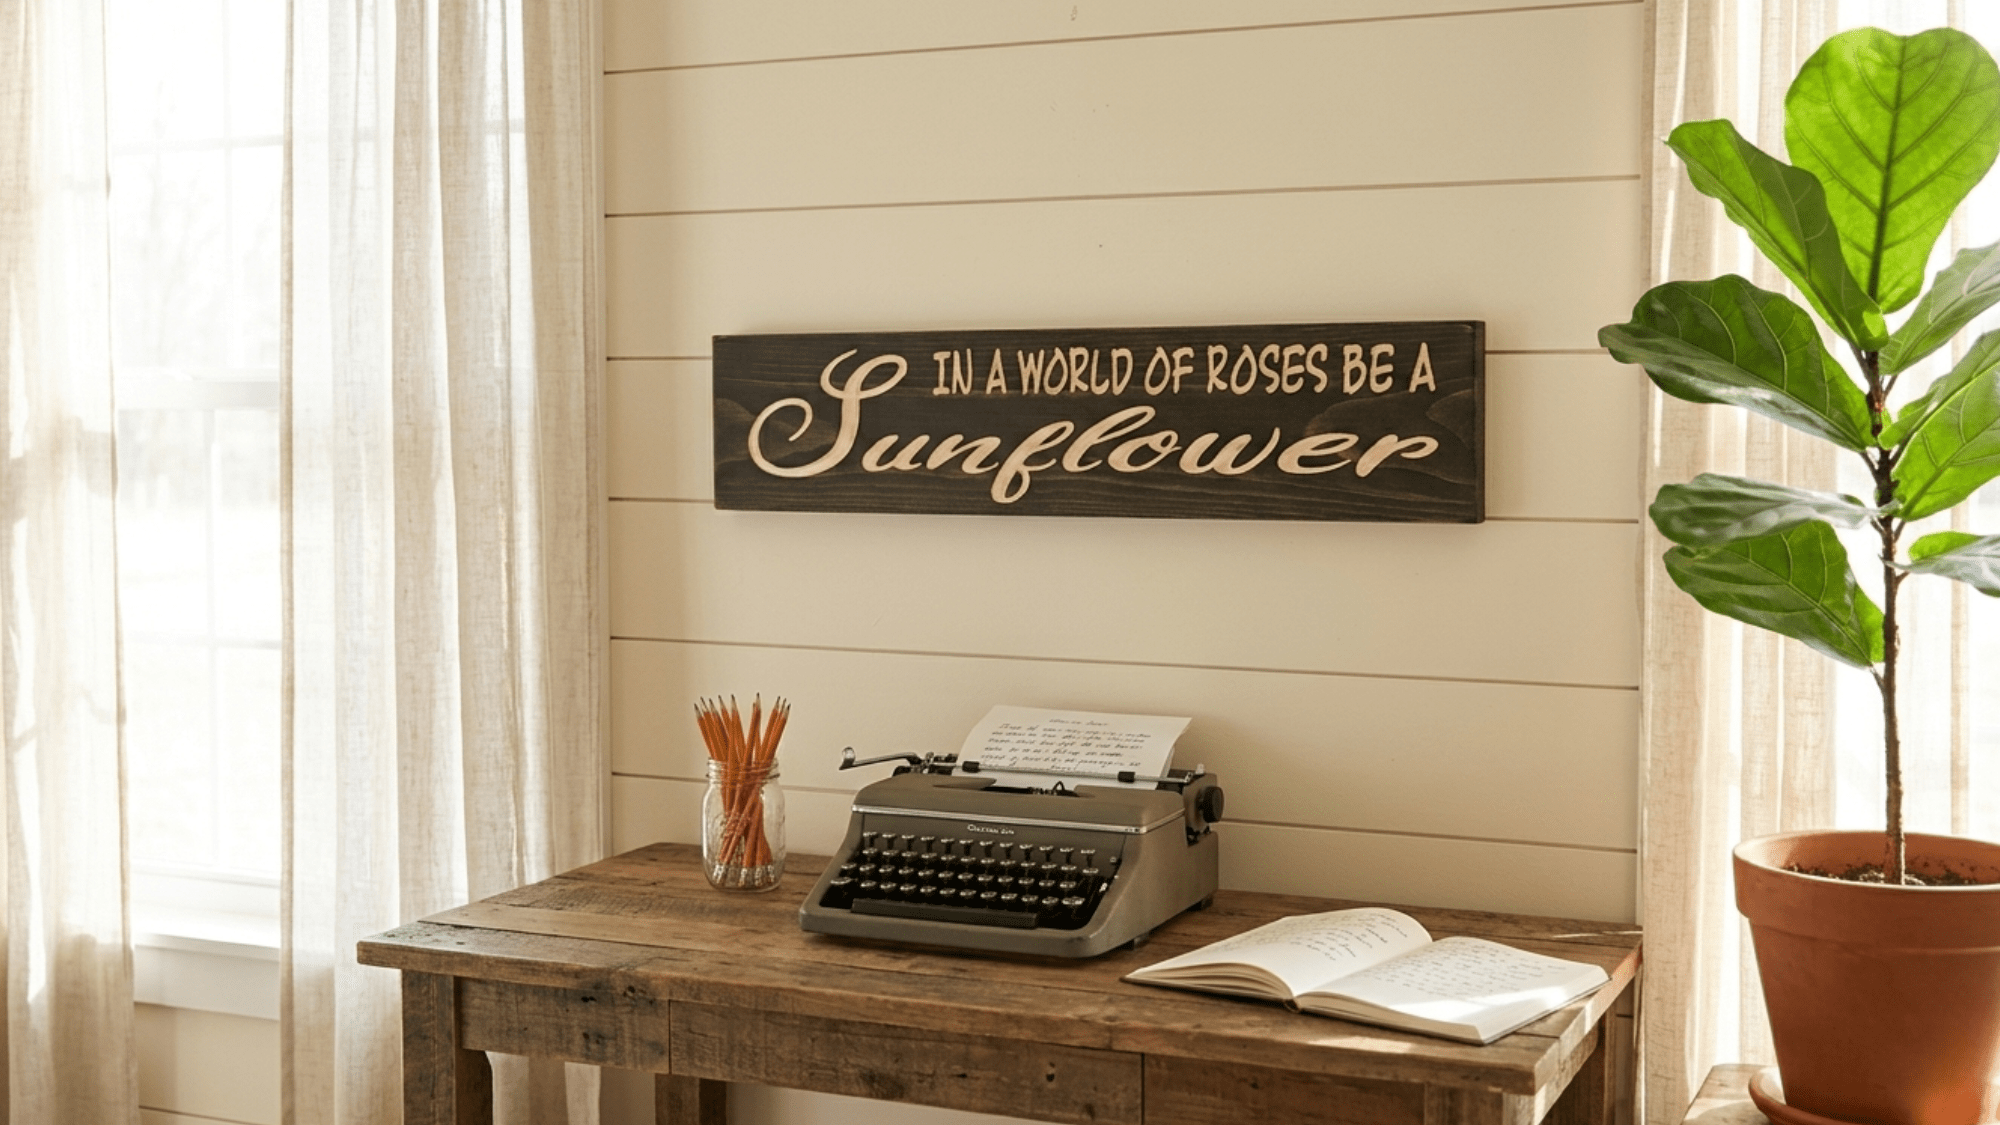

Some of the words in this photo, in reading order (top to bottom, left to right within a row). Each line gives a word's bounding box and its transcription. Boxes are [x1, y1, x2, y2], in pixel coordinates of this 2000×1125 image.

[932, 348, 973, 396] IN
[985, 348, 1008, 395] A
[1017, 346, 1133, 396] WORLD
[1144, 346, 1195, 396] OF
[1206, 343, 1328, 395] ROSES
[1342, 343, 1395, 395] BE
[1408, 342, 1436, 393] A
[747, 349, 1439, 504] Sunflower
